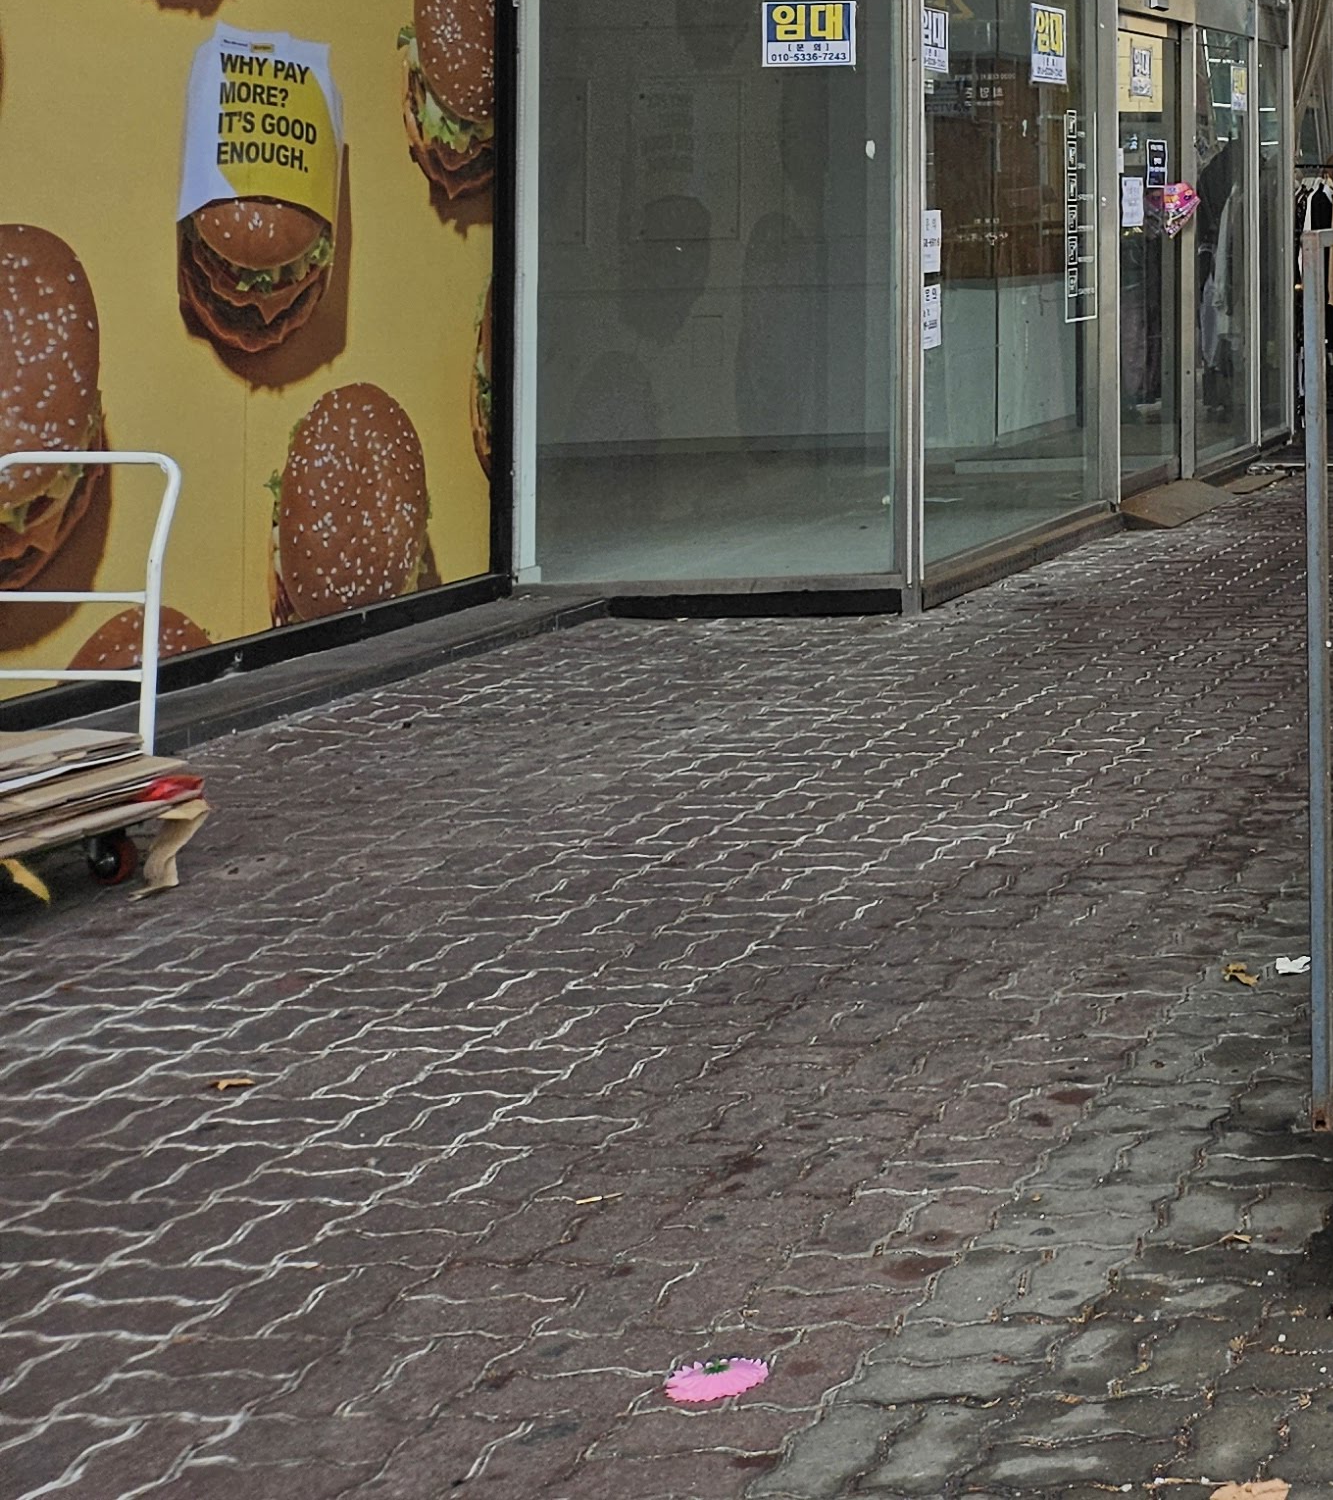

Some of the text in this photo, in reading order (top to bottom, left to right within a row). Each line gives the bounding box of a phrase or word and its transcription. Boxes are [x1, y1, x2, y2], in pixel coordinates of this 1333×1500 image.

[772, 3, 844, 40] 임대
[1035, 10, 1064, 57] 임대
[220, 52, 311, 85] WHY PAY
[771, 52, 847, 62] 010-5336-7243
[219, 81, 289, 108] MORE?
[218, 110, 317, 146] IT'S GOOD
[216, 141, 309, 174] ENOUGH.
